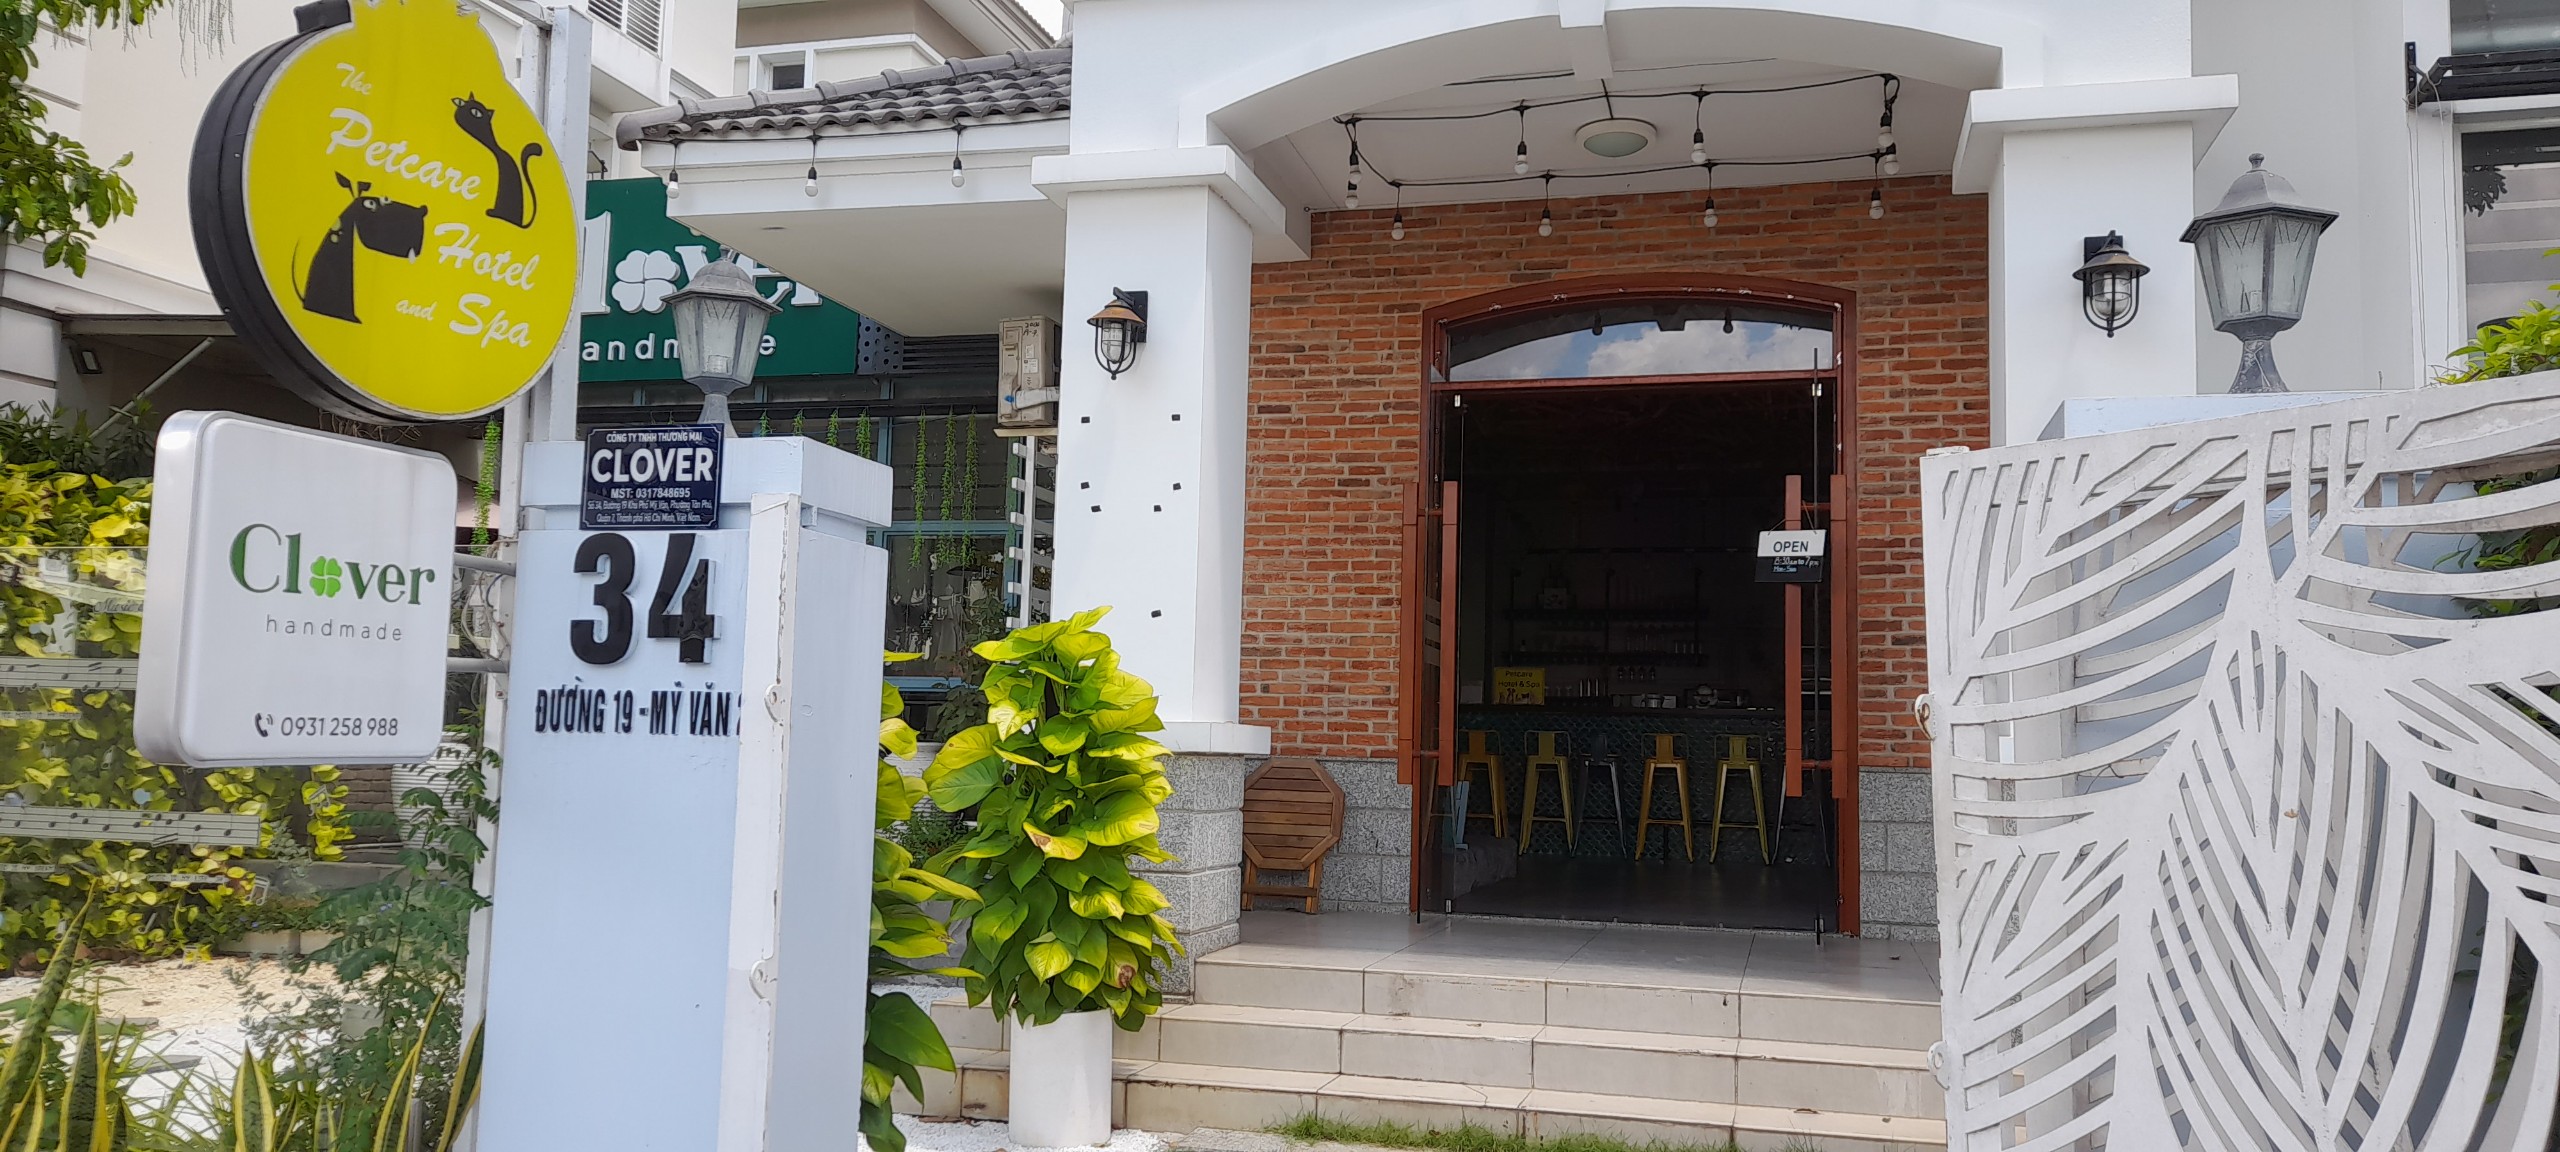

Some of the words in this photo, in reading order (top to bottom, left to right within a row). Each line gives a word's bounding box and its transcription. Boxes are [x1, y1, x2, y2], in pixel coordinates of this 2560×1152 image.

[336, 62, 371, 96] The
[326, 107, 481, 200] Petcare
[434, 222, 540, 291] Hotel
[395, 298, 437, 322] and
[449, 293, 532, 348] Spa
[627, 432, 637, 443] TY
[591, 447, 714, 483] CLOVER
[610, 488, 634, 499] MST:
[1773, 541, 1809, 553] OPEN
[570, 532, 720, 665] 34
[266, 614, 402, 641] handmade
[1505, 670, 1533, 678] Petcare
[535, 676, 606, 733] ĐƯỜNG
[613, 689, 634, 733] 19
[280, 716, 326, 737] 0931
[329, 717, 363, 737] 258
[366, 717, 399, 737] 988
